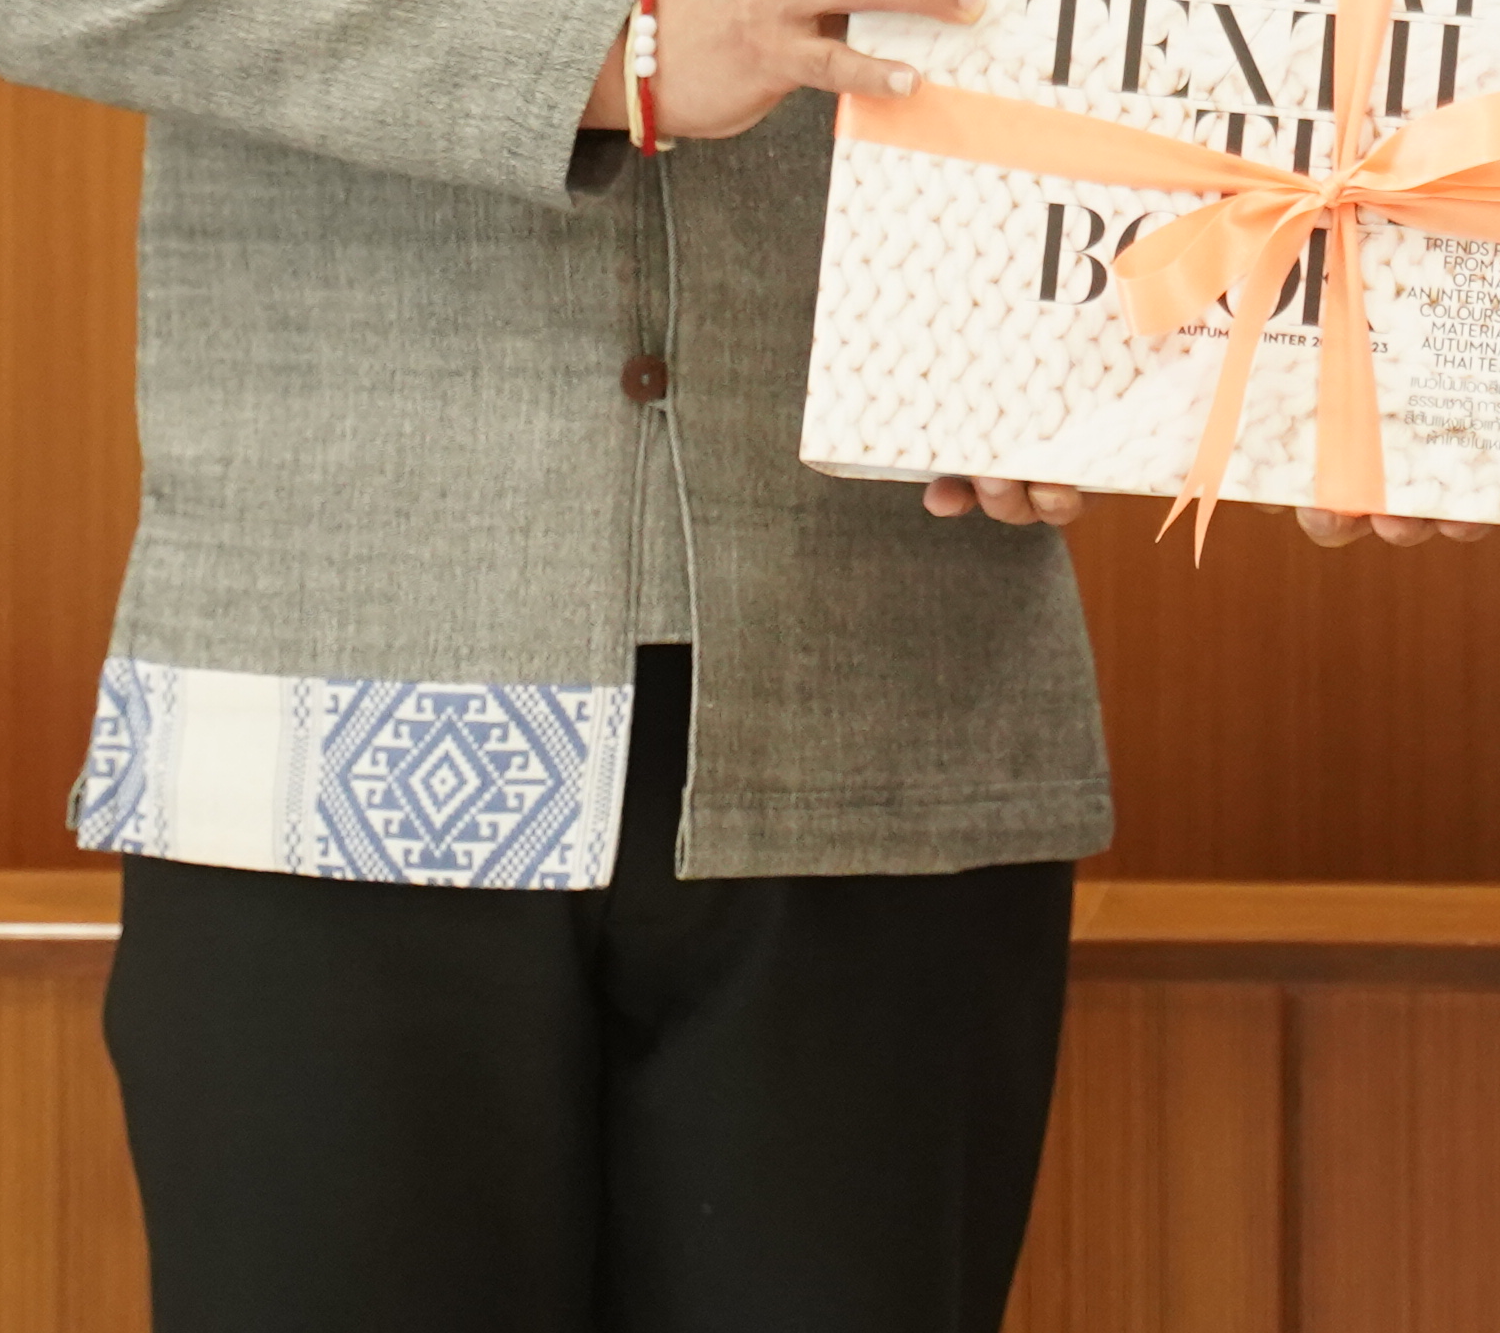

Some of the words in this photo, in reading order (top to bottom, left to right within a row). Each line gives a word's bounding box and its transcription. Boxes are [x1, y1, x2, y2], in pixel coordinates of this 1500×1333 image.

[1423, 237, 1489, 256] TRENDS
[1444, 255, 1494, 273] FROM
[1453, 273, 1479, 288] OF
[1407, 286, 1431, 300] AN
[1434, 353, 1473, 371] THAI
[1408, 394, 1474, 414] ธรรมชาติ
